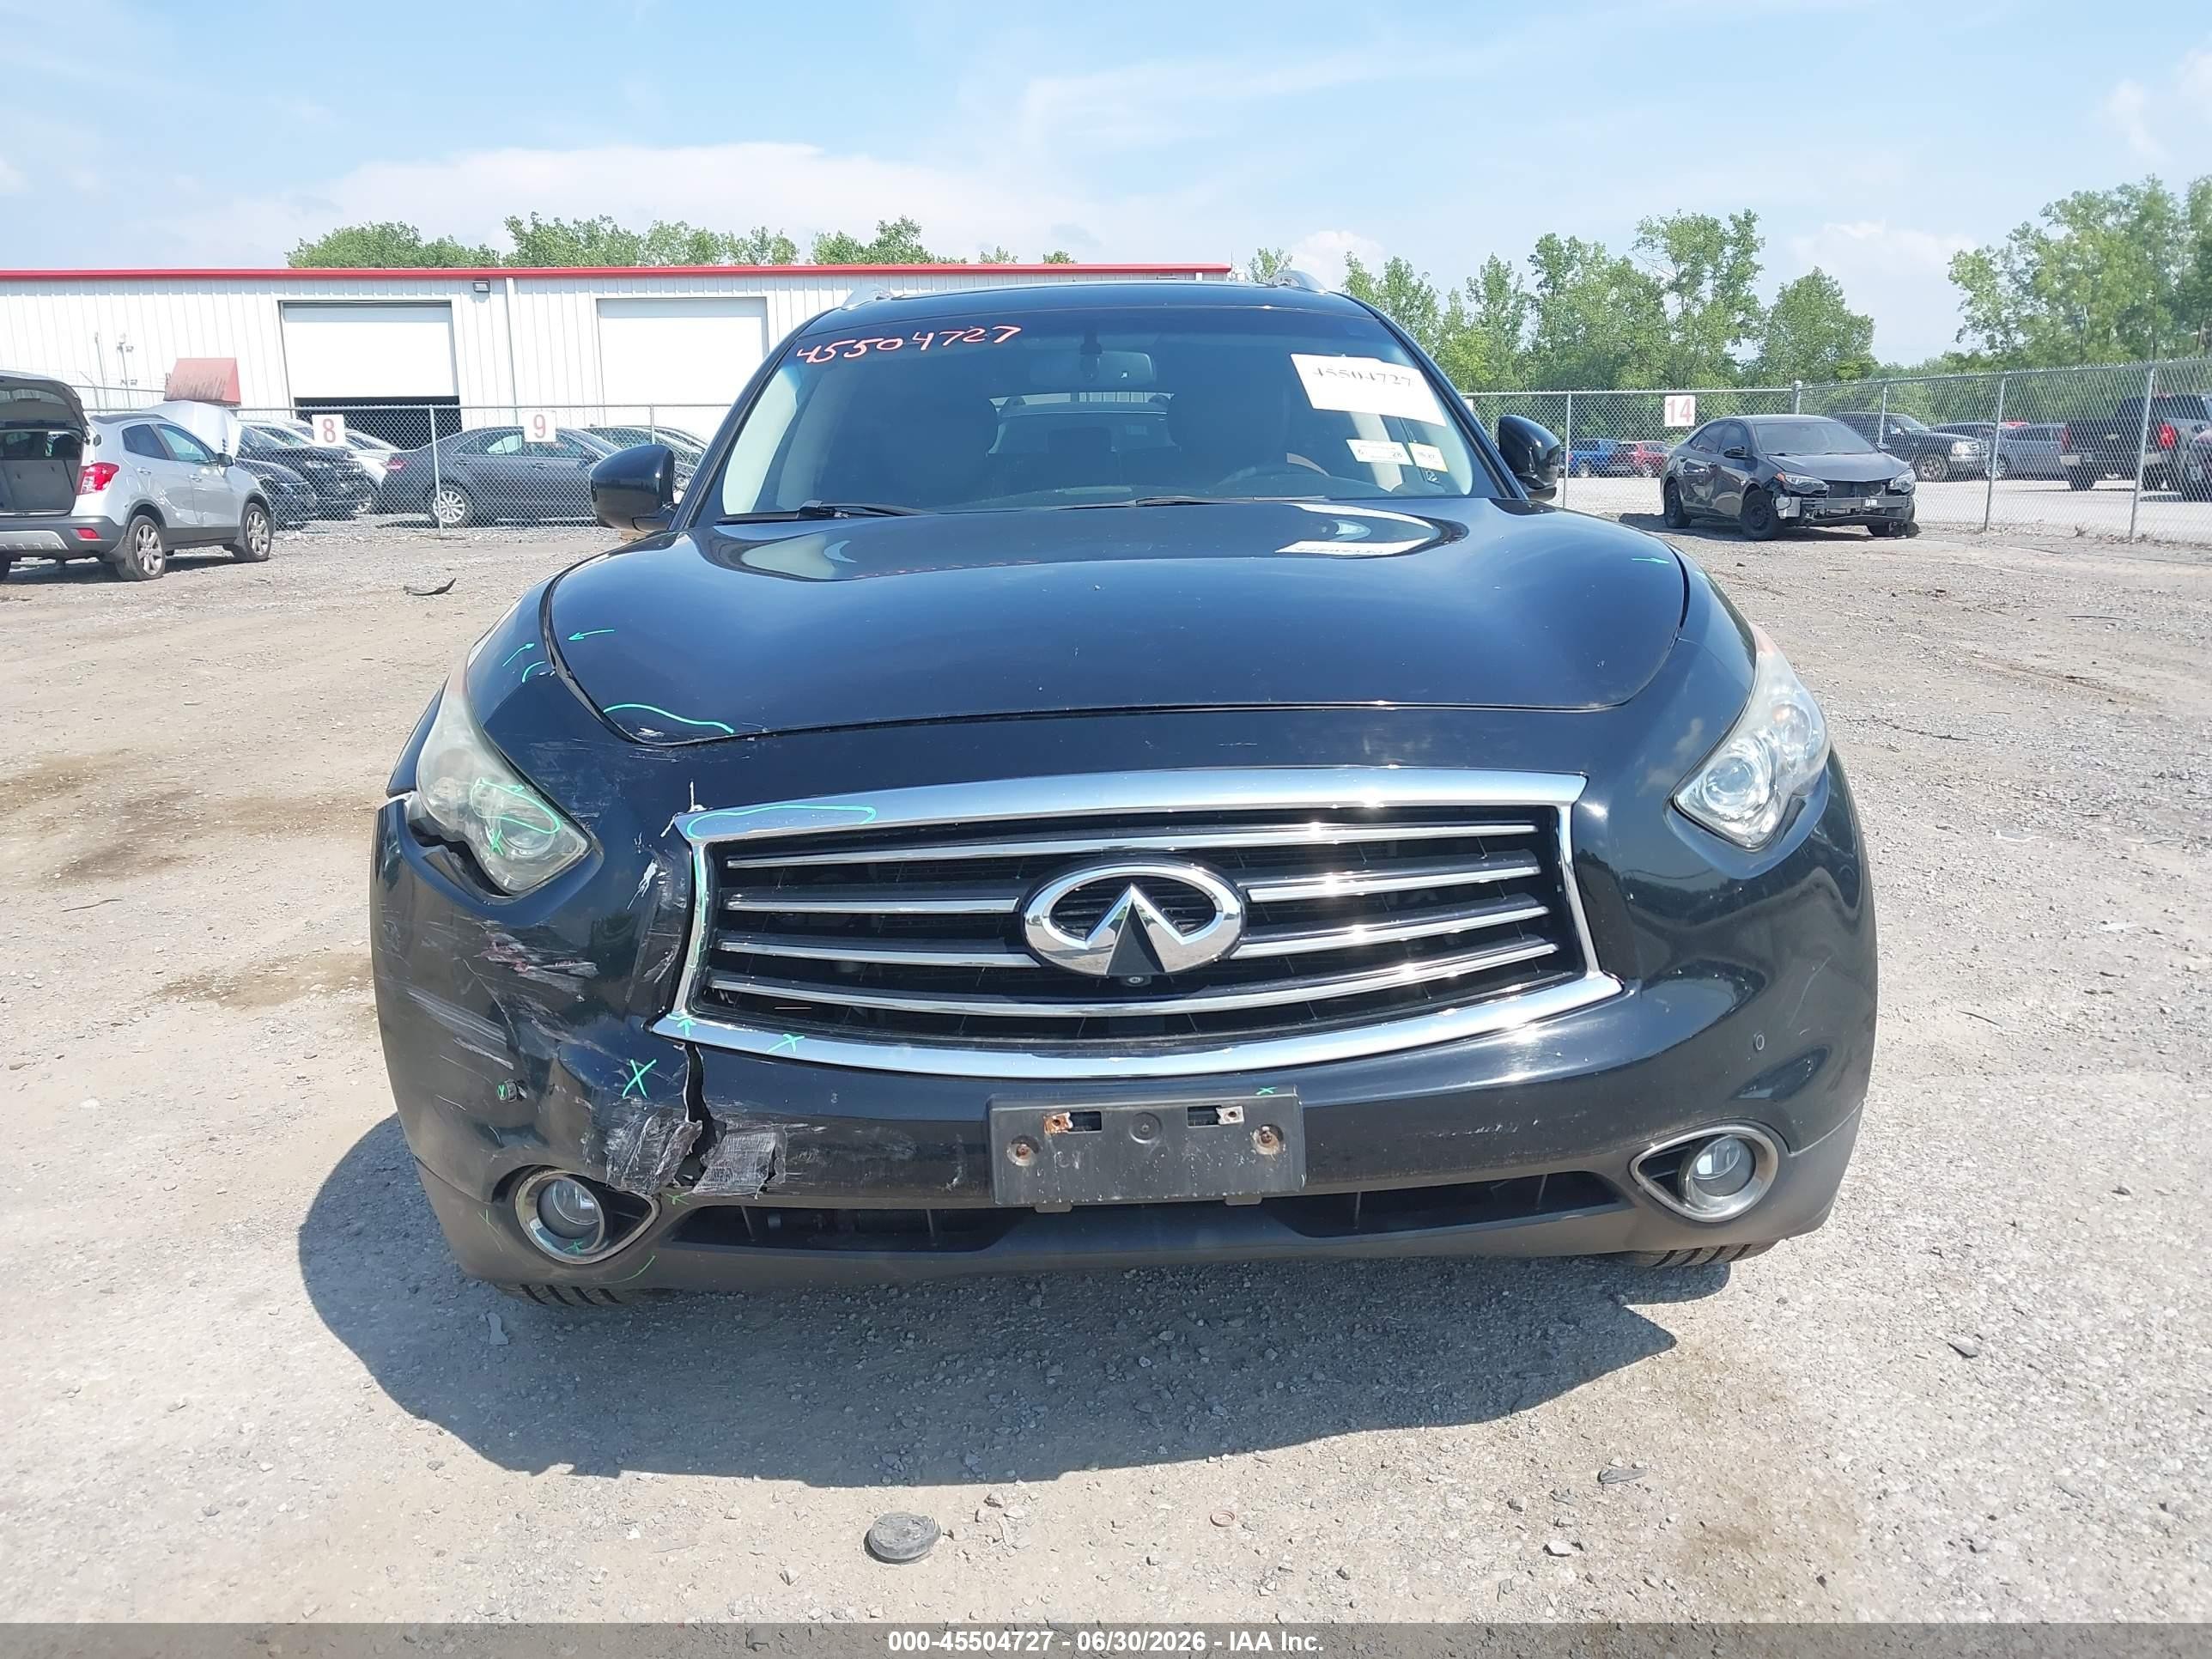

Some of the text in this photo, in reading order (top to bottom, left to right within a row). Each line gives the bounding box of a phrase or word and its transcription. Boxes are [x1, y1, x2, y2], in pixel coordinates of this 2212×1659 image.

[796, 325, 1023, 364] 45504727
[1667, 398, 1692, 423] 14
[322, 418, 336, 443] 8
[533, 414, 546, 439] 9
